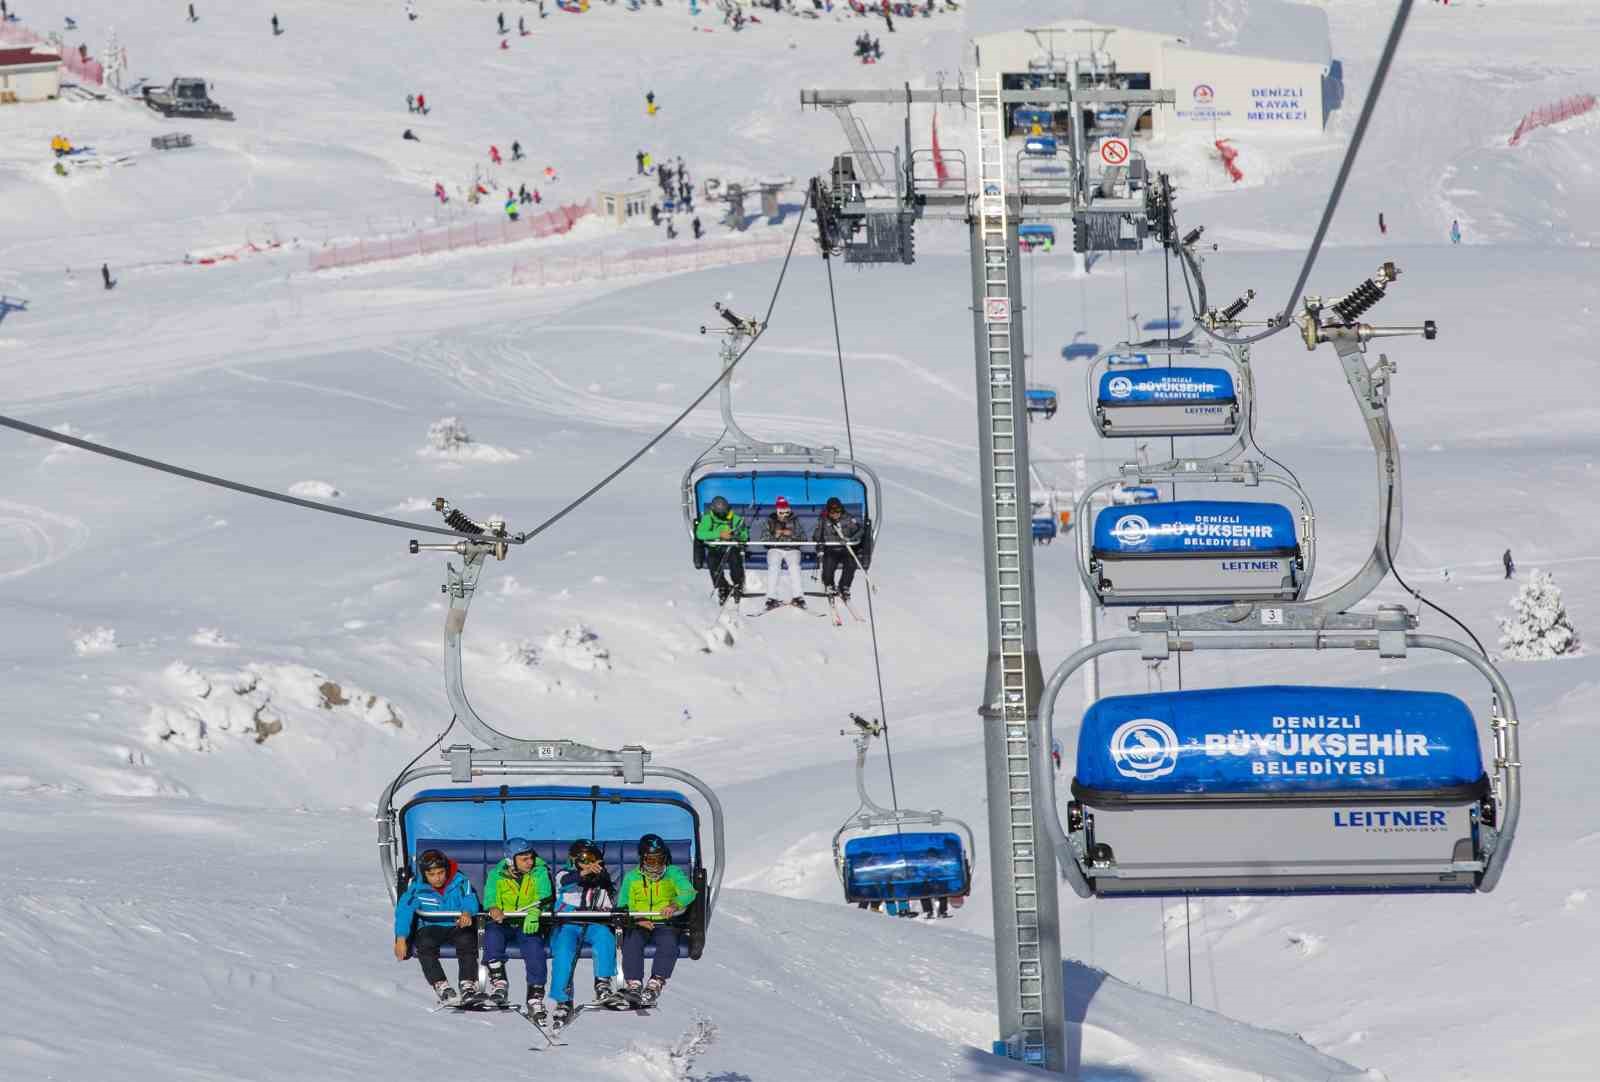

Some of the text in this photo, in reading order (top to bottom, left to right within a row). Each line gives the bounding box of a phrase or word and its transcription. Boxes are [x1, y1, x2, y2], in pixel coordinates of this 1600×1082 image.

[1255, 100, 1299, 108] KAYAK
[1221, 561, 1279, 570] LEITNER
[1272, 715, 1361, 729] DENİZLİ
[1204, 729, 1430, 758] BÜYÜKŞEHİR
[1252, 758, 1385, 775] BELEDİYESİ
[1333, 810, 1447, 827] LEITNER
